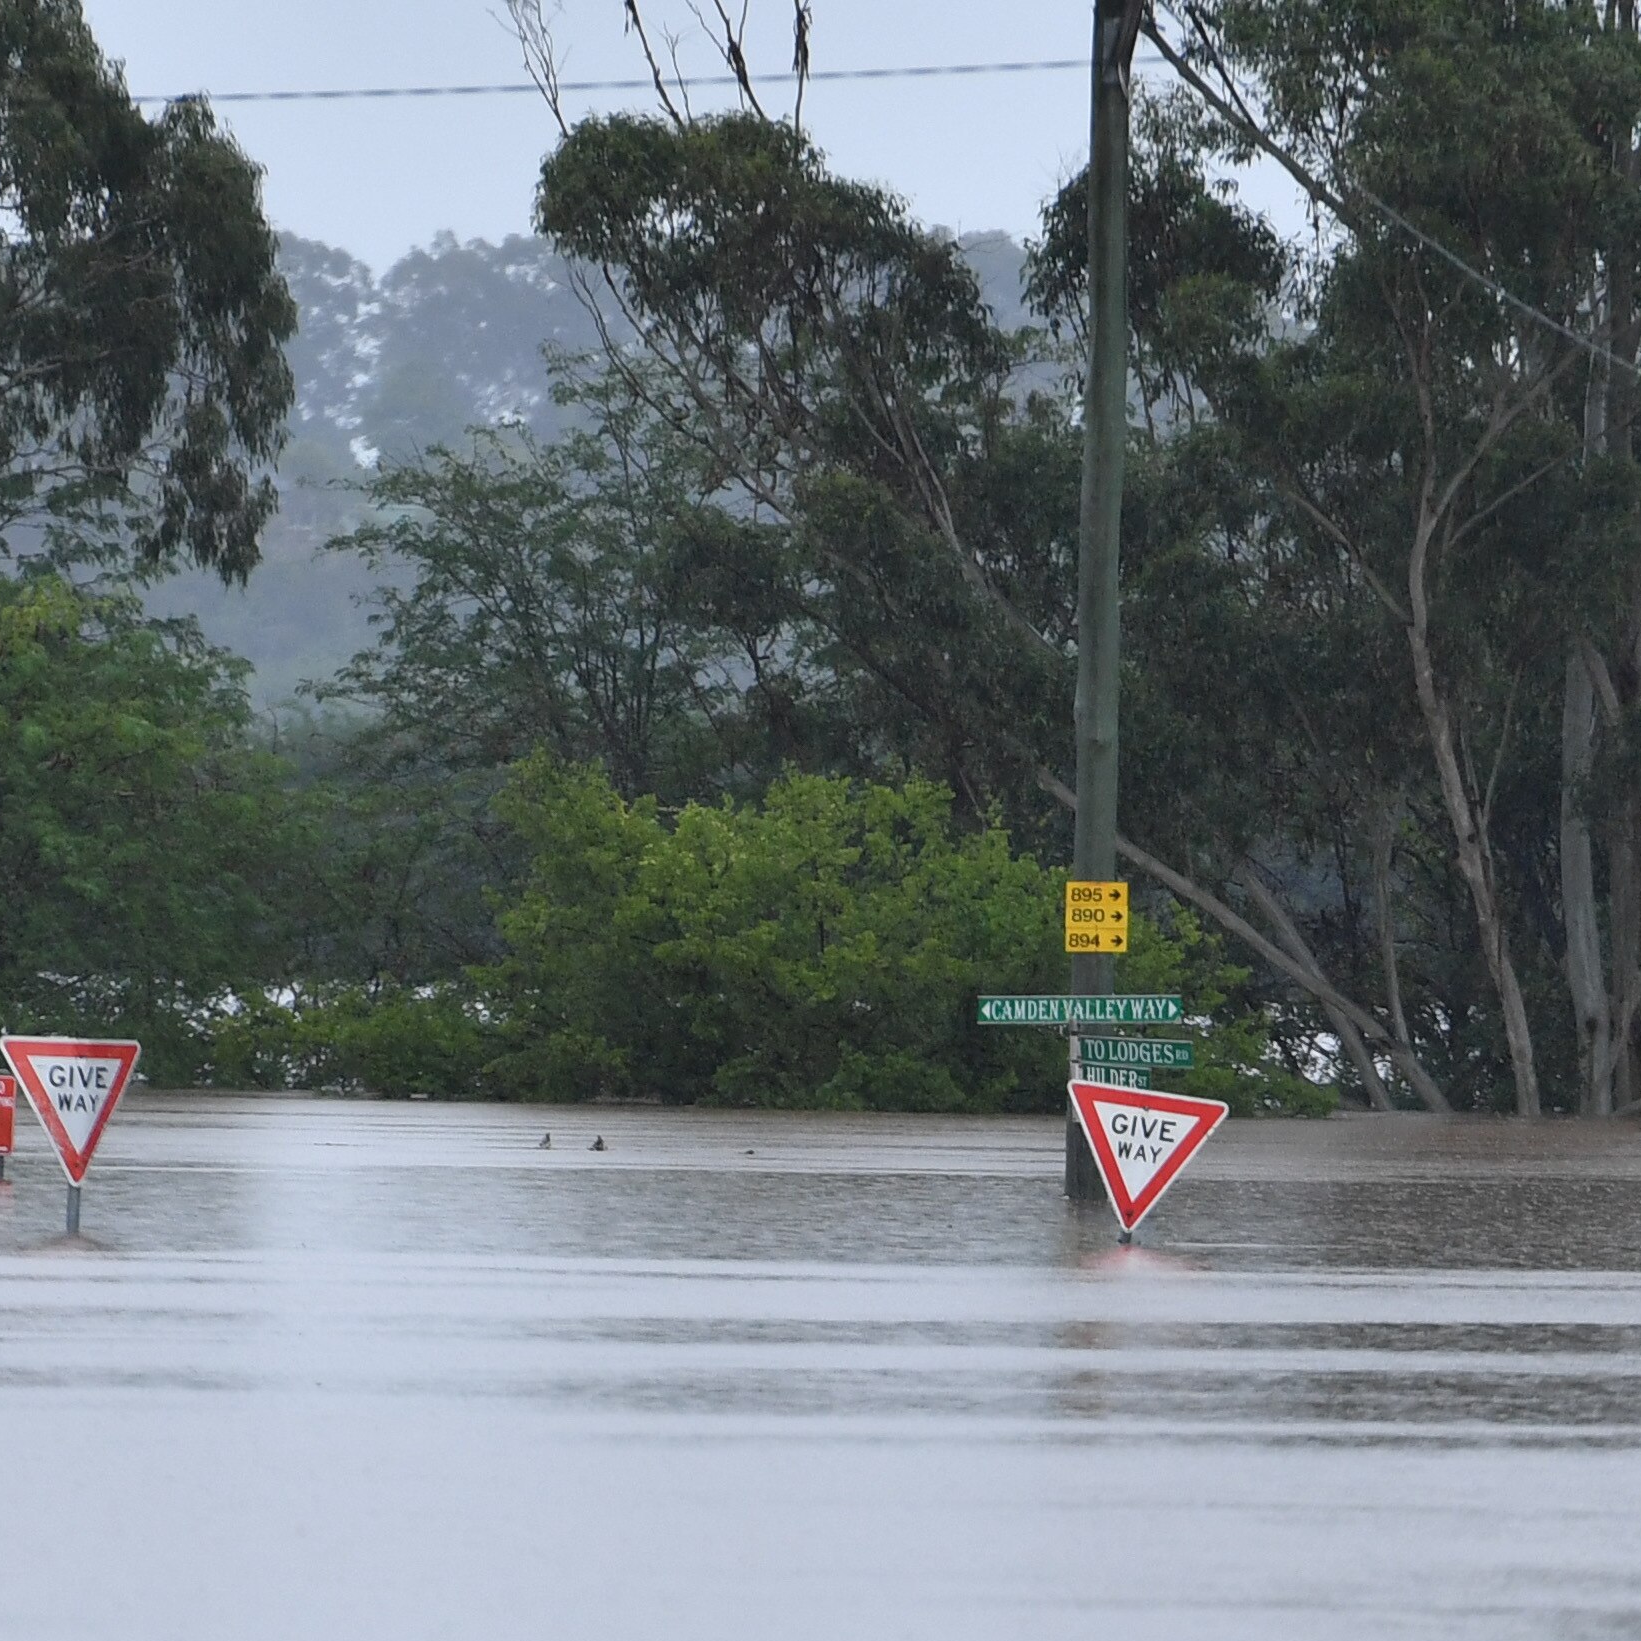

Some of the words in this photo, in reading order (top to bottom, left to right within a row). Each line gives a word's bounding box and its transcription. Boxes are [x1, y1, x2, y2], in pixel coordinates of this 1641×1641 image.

[1071, 888, 1103, 902] 895
[1072, 908, 1105, 923] 890
[1069, 933, 1100, 948] 894
[991, 1000, 1059, 1020] CAMDEN
[1063, 999, 1127, 1020] VALLEY
[1131, 999, 1167, 1019] WAY
[1085, 1040, 1105, 1060] TO
[1109, 1041, 1175, 1064] LODGES
[1175, 1049, 1189, 1060] RD
[49, 1064, 108, 1089] GIVE
[1138, 1076, 1147, 1087] ST
[58, 1094, 99, 1113] WAY
[1111, 1113, 1177, 1143] GIVE
[1118, 1141, 1163, 1164] WAY
